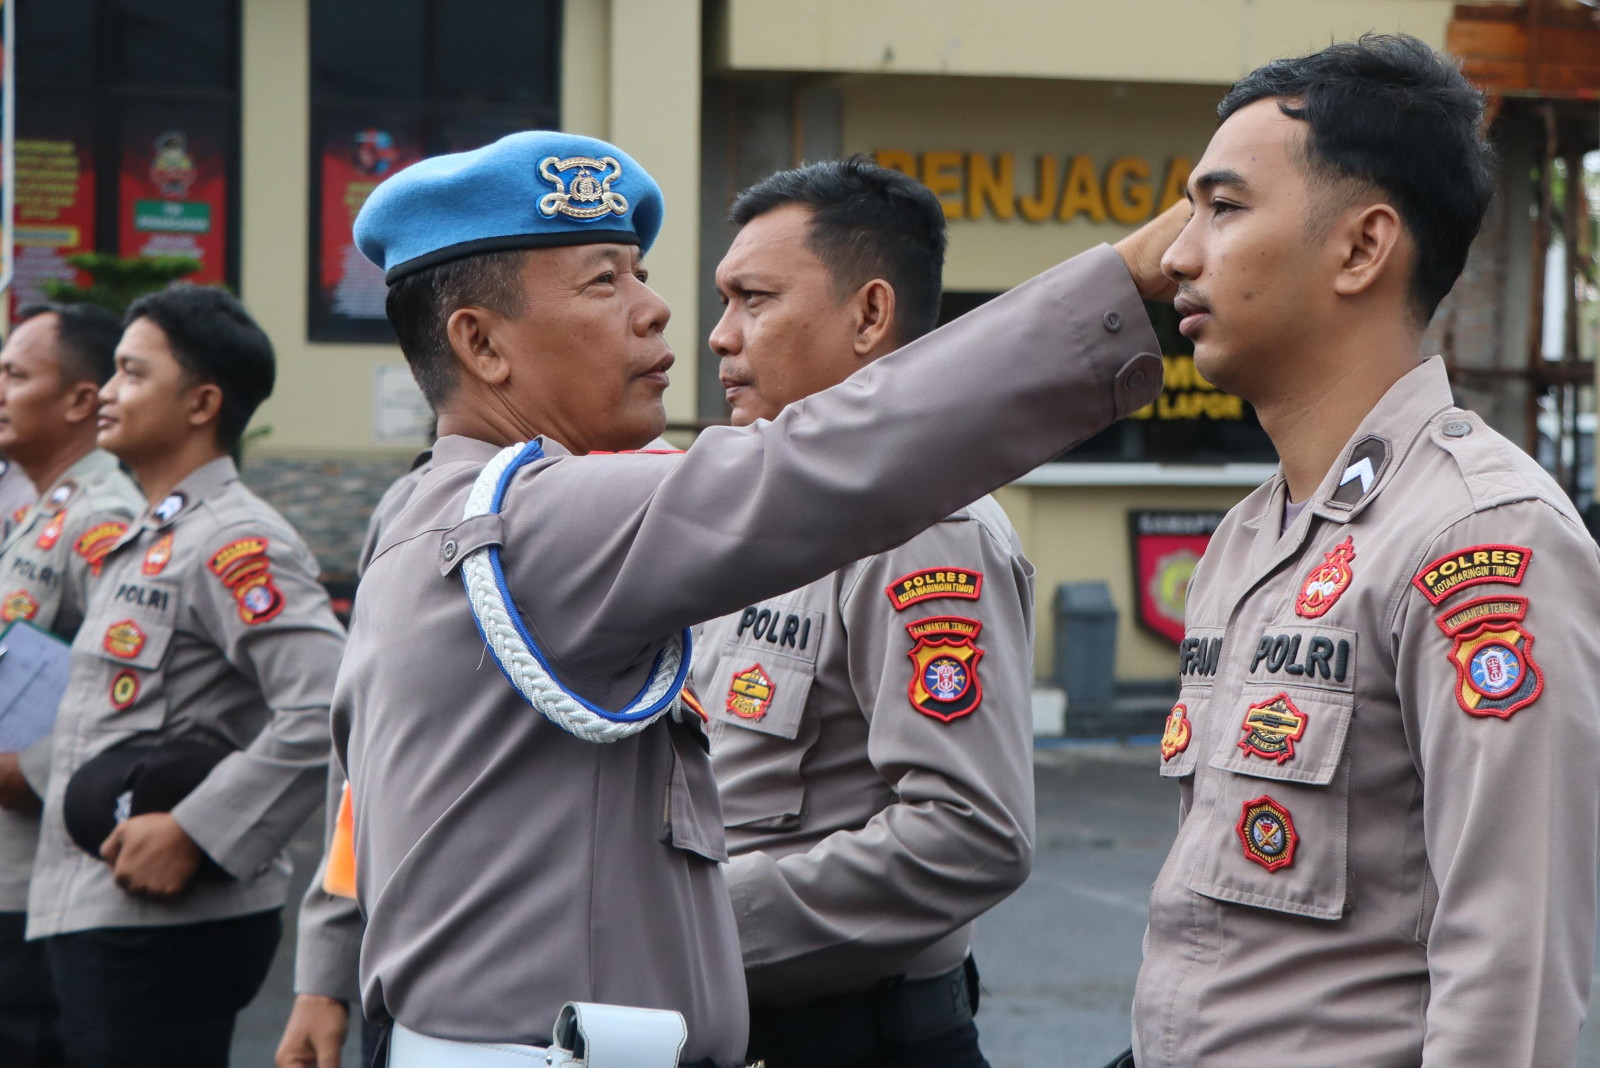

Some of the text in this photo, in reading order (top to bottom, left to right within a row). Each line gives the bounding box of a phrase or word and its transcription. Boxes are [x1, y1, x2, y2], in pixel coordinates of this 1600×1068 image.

[902, 571, 968, 592] POLRES
[1424, 550, 1521, 587] POLRES
[1431, 564, 1515, 597] KOTAWARINGIN TIMUR
[115, 583, 169, 611] POLRI
[897, 582, 975, 604] KOTAWARINGIN TIMUR
[737, 605, 811, 650] POLRI
[1446, 603, 1519, 629] KALIMANTAN TENGAH
[1180, 637, 1224, 677] FAN
[1250, 634, 1349, 682] POLRI
